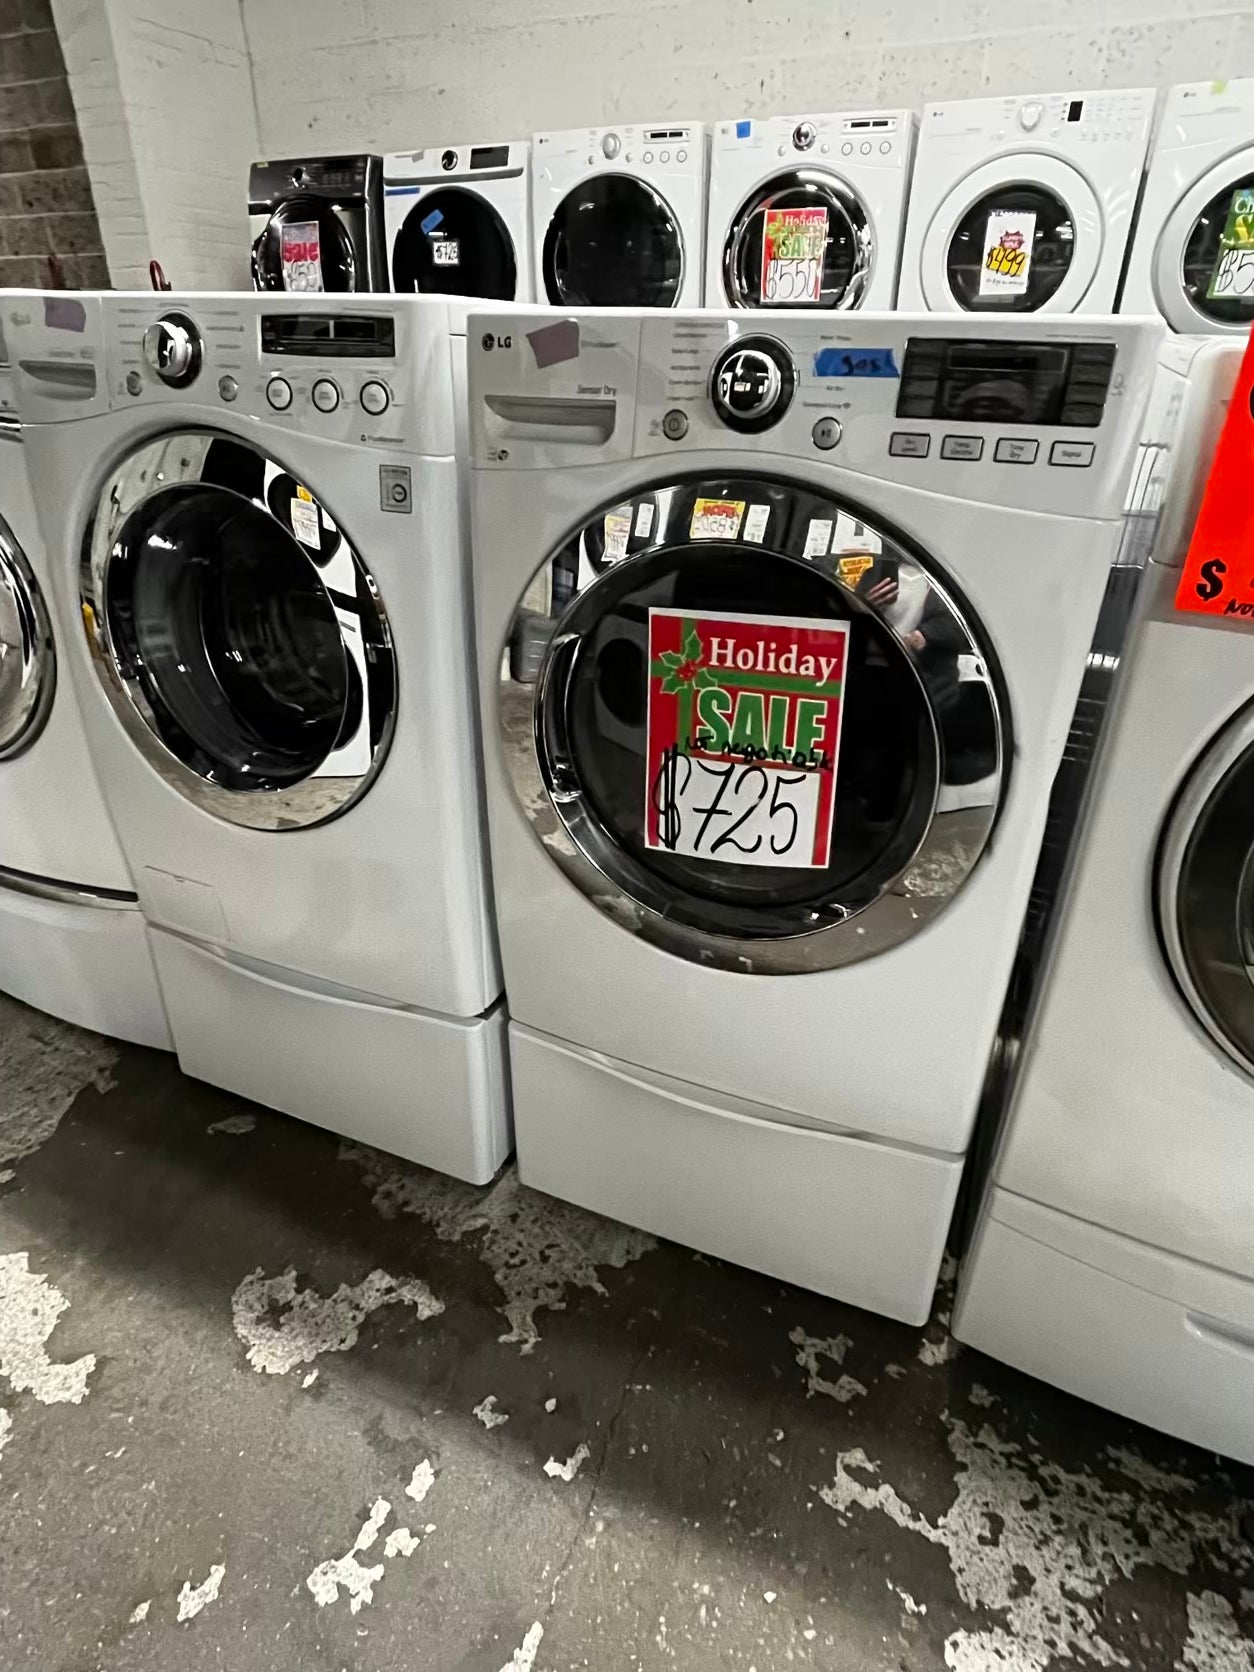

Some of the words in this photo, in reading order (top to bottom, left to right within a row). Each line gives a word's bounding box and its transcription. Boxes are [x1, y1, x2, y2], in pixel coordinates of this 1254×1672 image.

[785, 214, 825, 228] Holiday
[779, 232, 821, 259] SALE
[986, 247, 1026, 277] $499
[765, 258, 817, 299] $550
[1217, 249, 1254, 295] $5
[497, 335, 512, 348] LG
[1196, 558, 1227, 601] $
[709, 636, 839, 687] Holiday
[697, 686, 829, 766] SALE
[652, 742, 807, 856] $725
